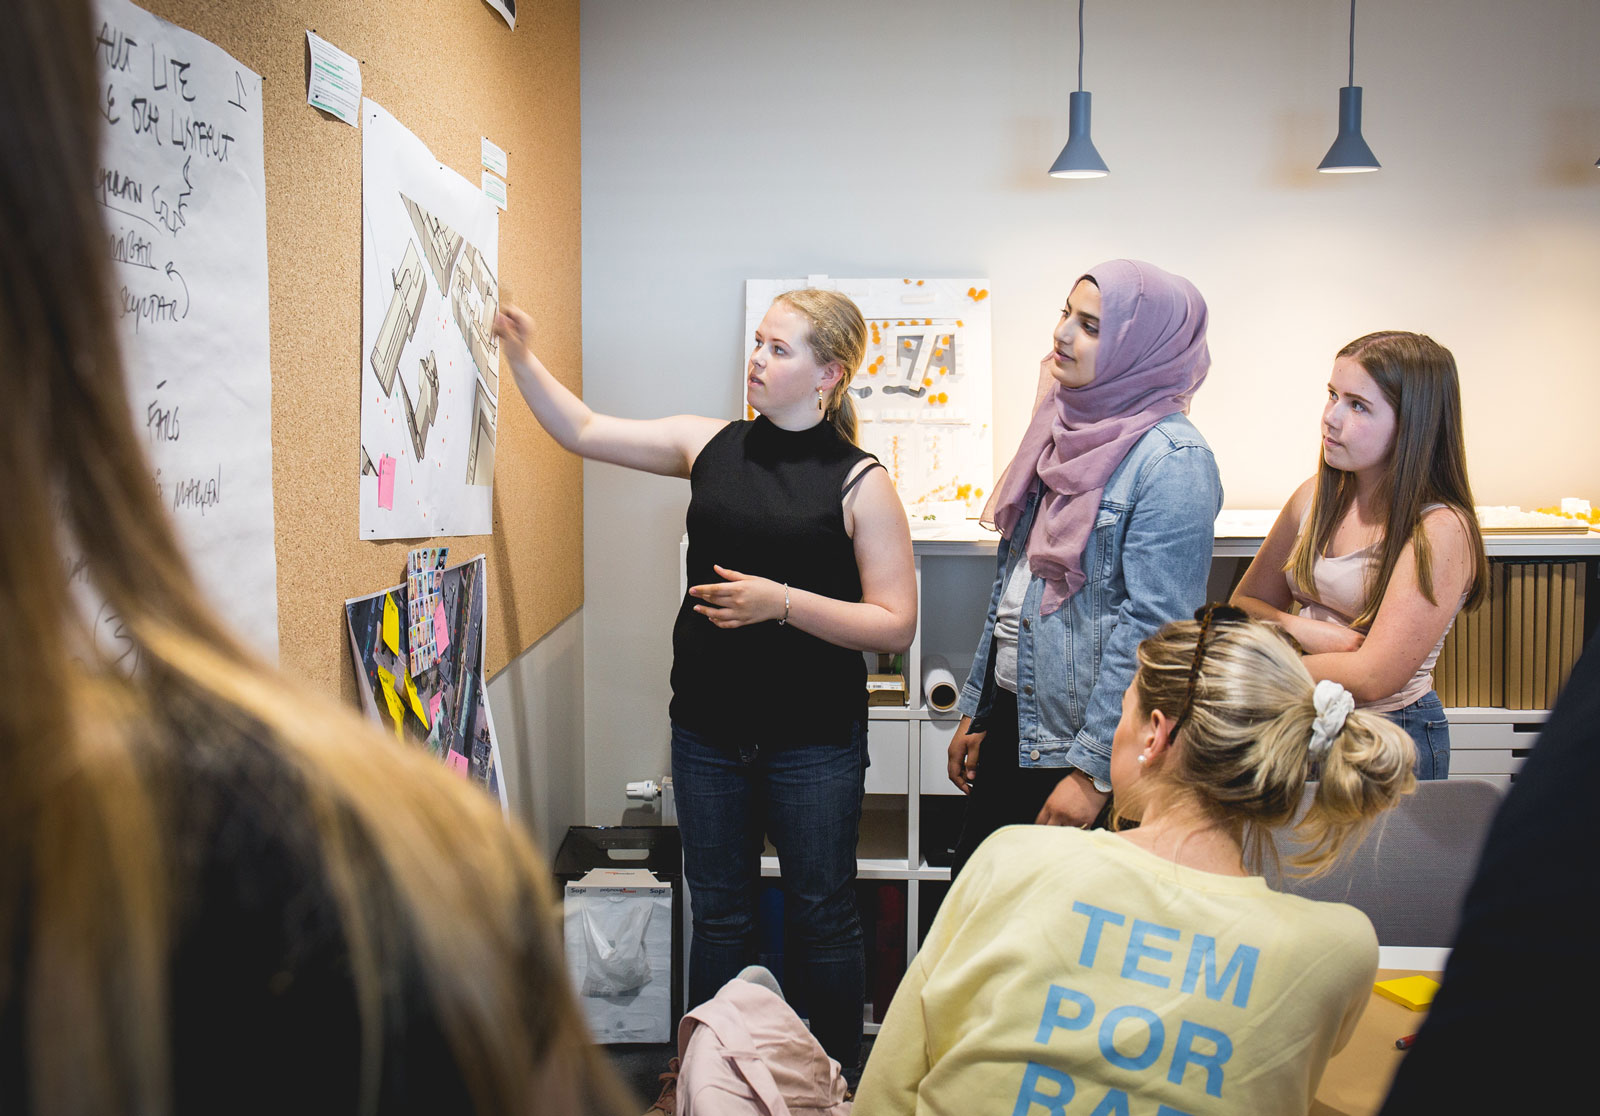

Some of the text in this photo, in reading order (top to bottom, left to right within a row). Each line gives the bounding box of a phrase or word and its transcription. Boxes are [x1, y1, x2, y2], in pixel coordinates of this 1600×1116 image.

[151, 42, 196, 103] LITE
[1072, 900, 1261, 1009] TEM
[1034, 984, 1234, 1099] POR
